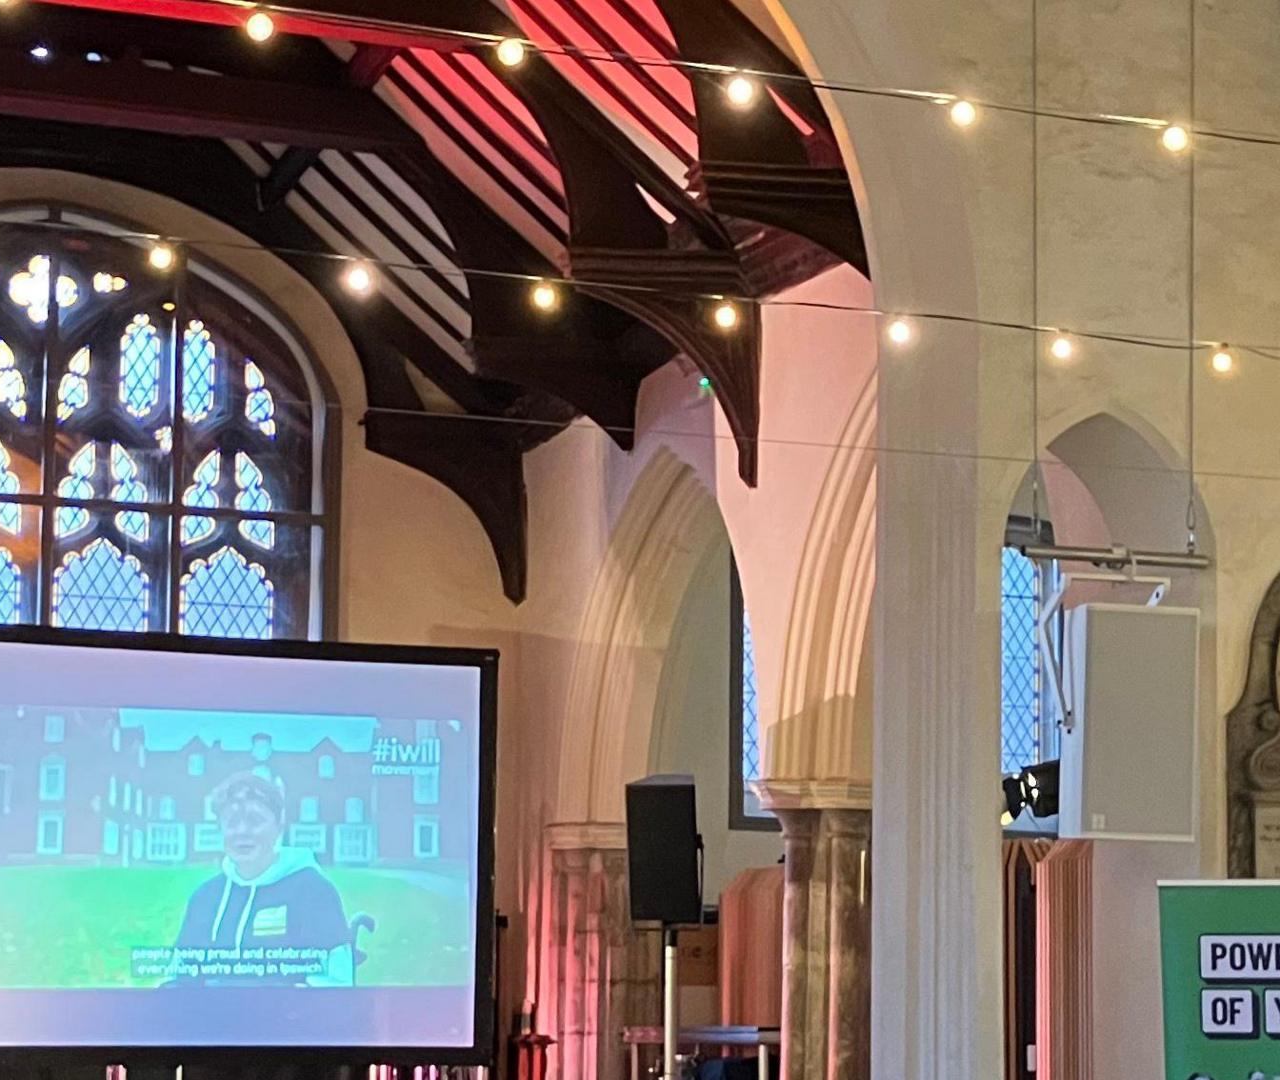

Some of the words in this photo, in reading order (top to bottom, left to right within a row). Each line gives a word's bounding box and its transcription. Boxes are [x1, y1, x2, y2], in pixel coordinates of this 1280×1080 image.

[372, 737, 440, 763] #iwill
[243, 947, 264, 960] and
[266, 947, 328, 961] celebrating
[233, 962, 265, 976] doing
[266, 962, 278, 974] in
[1211, 997, 1245, 1026] OF
